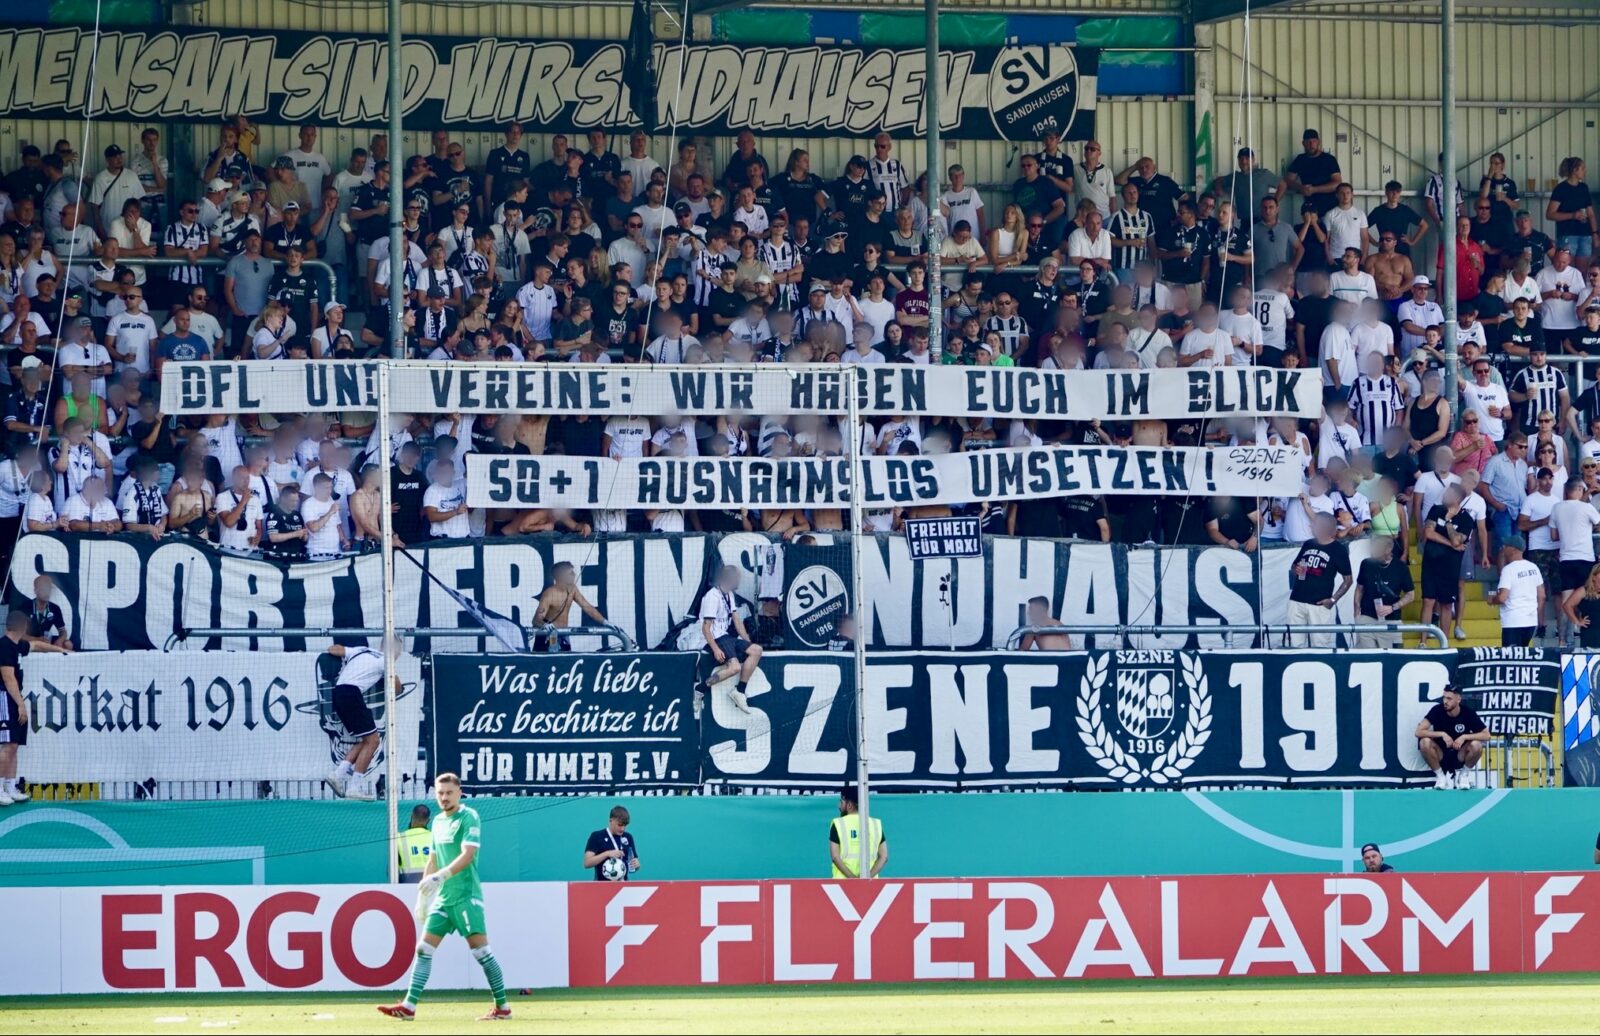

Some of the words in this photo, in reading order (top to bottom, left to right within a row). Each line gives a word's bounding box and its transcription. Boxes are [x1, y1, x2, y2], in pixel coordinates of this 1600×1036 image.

[281, 36, 438, 124] SIND
[442, 37, 574, 124] WIR
[1001, 46, 1050, 95] SV
[1006, 83, 1070, 124] SANDHAUSEN
[181, 364, 260, 409] DFL
[430, 369, 631, 410] VEREINE:
[670, 370, 753, 410] WIR
[791, 367, 927, 411] HABEN
[966, 370, 1068, 415] EUCH
[1106, 372, 1150, 415] IM
[1188, 370, 1300, 413] BLICK
[489, 458, 599, 503] 50+1
[638, 459, 939, 504] AUSNAHMSLOS
[910, 521, 977, 538] FREIHEIT
[912, 538, 940, 555] FÜR
[943, 538, 978, 554] MAX!
[1307, 555, 1319, 569] 90
[795, 573, 828, 609] SV
[799, 601, 842, 628] SANDHAUSEN
[816, 622, 833, 637] 1916
[1116, 649, 1175, 664] SZENE
[1473, 647, 1544, 661] NIEMALS
[478, 665, 539, 693] Was
[547, 659, 583, 694] ich
[593, 658, 658, 696] liebe,
[1474, 667, 1541, 685] ALLEINE
[181, 676, 291, 732] 1916
[458, 699, 506, 733] das
[511, 699, 636, 734] beschütze
[643, 698, 680, 732] ich
[708, 662, 1060, 775] SZENE
[1228, 661, 1450, 772] 1916
[1482, 692, 1532, 709] IMMER
[460, 747, 513, 781] FÜR
[526, 752, 613, 781] IMMER
[624, 752, 680, 780] E.V.
[1128, 739, 1165, 754] 1916
[101, 891, 416, 991] ERGO
[700, 876, 1490, 983] FLYERALARM
